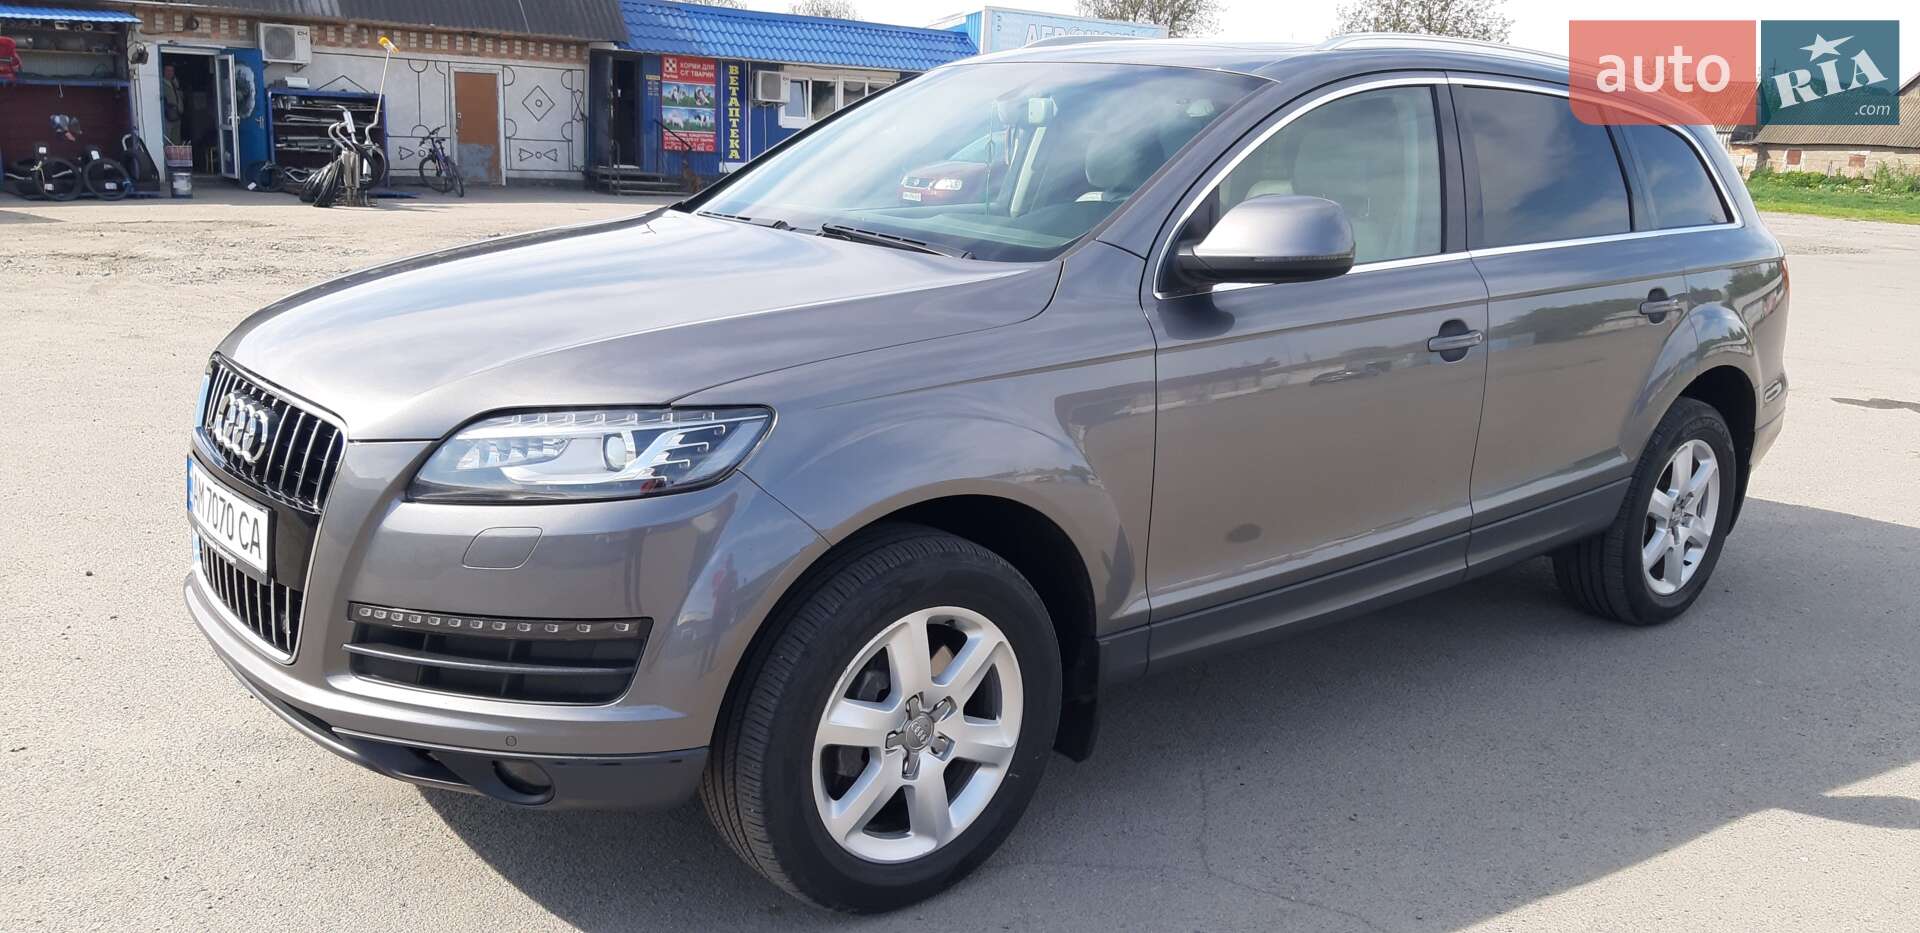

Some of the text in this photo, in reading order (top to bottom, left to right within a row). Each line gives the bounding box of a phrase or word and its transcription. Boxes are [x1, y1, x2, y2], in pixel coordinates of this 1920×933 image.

[728, 65, 740, 160] ВЕТАПТЕКА
[206, 486, 234, 540] 7070
[239, 511, 262, 561] CA
